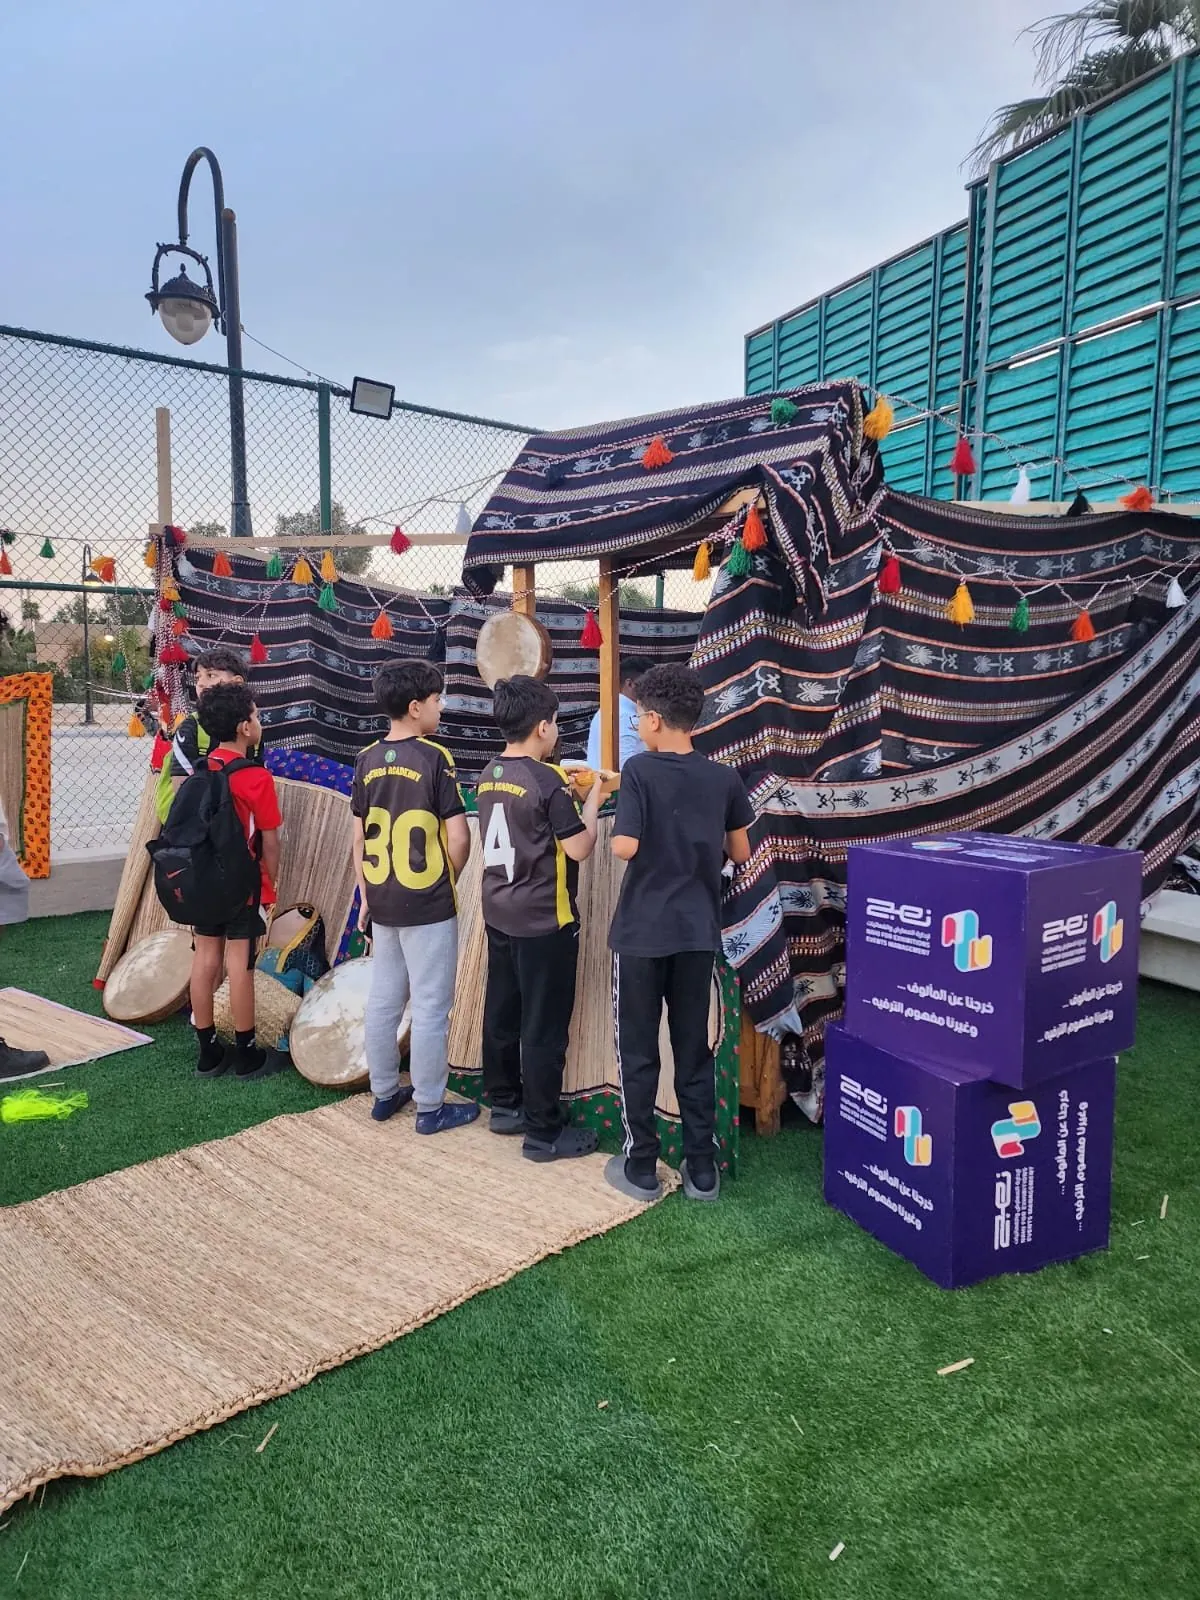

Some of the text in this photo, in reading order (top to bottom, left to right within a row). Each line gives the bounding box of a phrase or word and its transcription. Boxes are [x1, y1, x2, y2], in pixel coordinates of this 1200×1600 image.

[387, 765, 423, 782] ACADEMY
[494, 781, 528, 798] ACADEMY
[362, 806, 445, 890] 30
[483, 802, 516, 883] 4
[906, 982, 947, 1001] المألوف
[947, 991, 964, 1006] عن
[871, 996, 904, 1014] الترفيه
[965, 995, 994, 1014] خرجنا
[904, 1007, 946, 1027] مفهوم
[946, 1015, 978, 1038] وغيرنا
[1057, 1089, 1070, 1120] خرجنا
[1057, 1120, 1069, 1138] عن
[1076, 1101, 1089, 1136] وغيرنا
[1054, 1139, 1068, 1184] المألوف
[1076, 1136, 1086, 1181] مفهوم
[867, 1186, 898, 1213] مفهوم
[899, 1182, 912, 1197] عن
[911, 1188, 934, 1211] خرجنا
[1074, 1183, 1085, 1221] الترفيه
